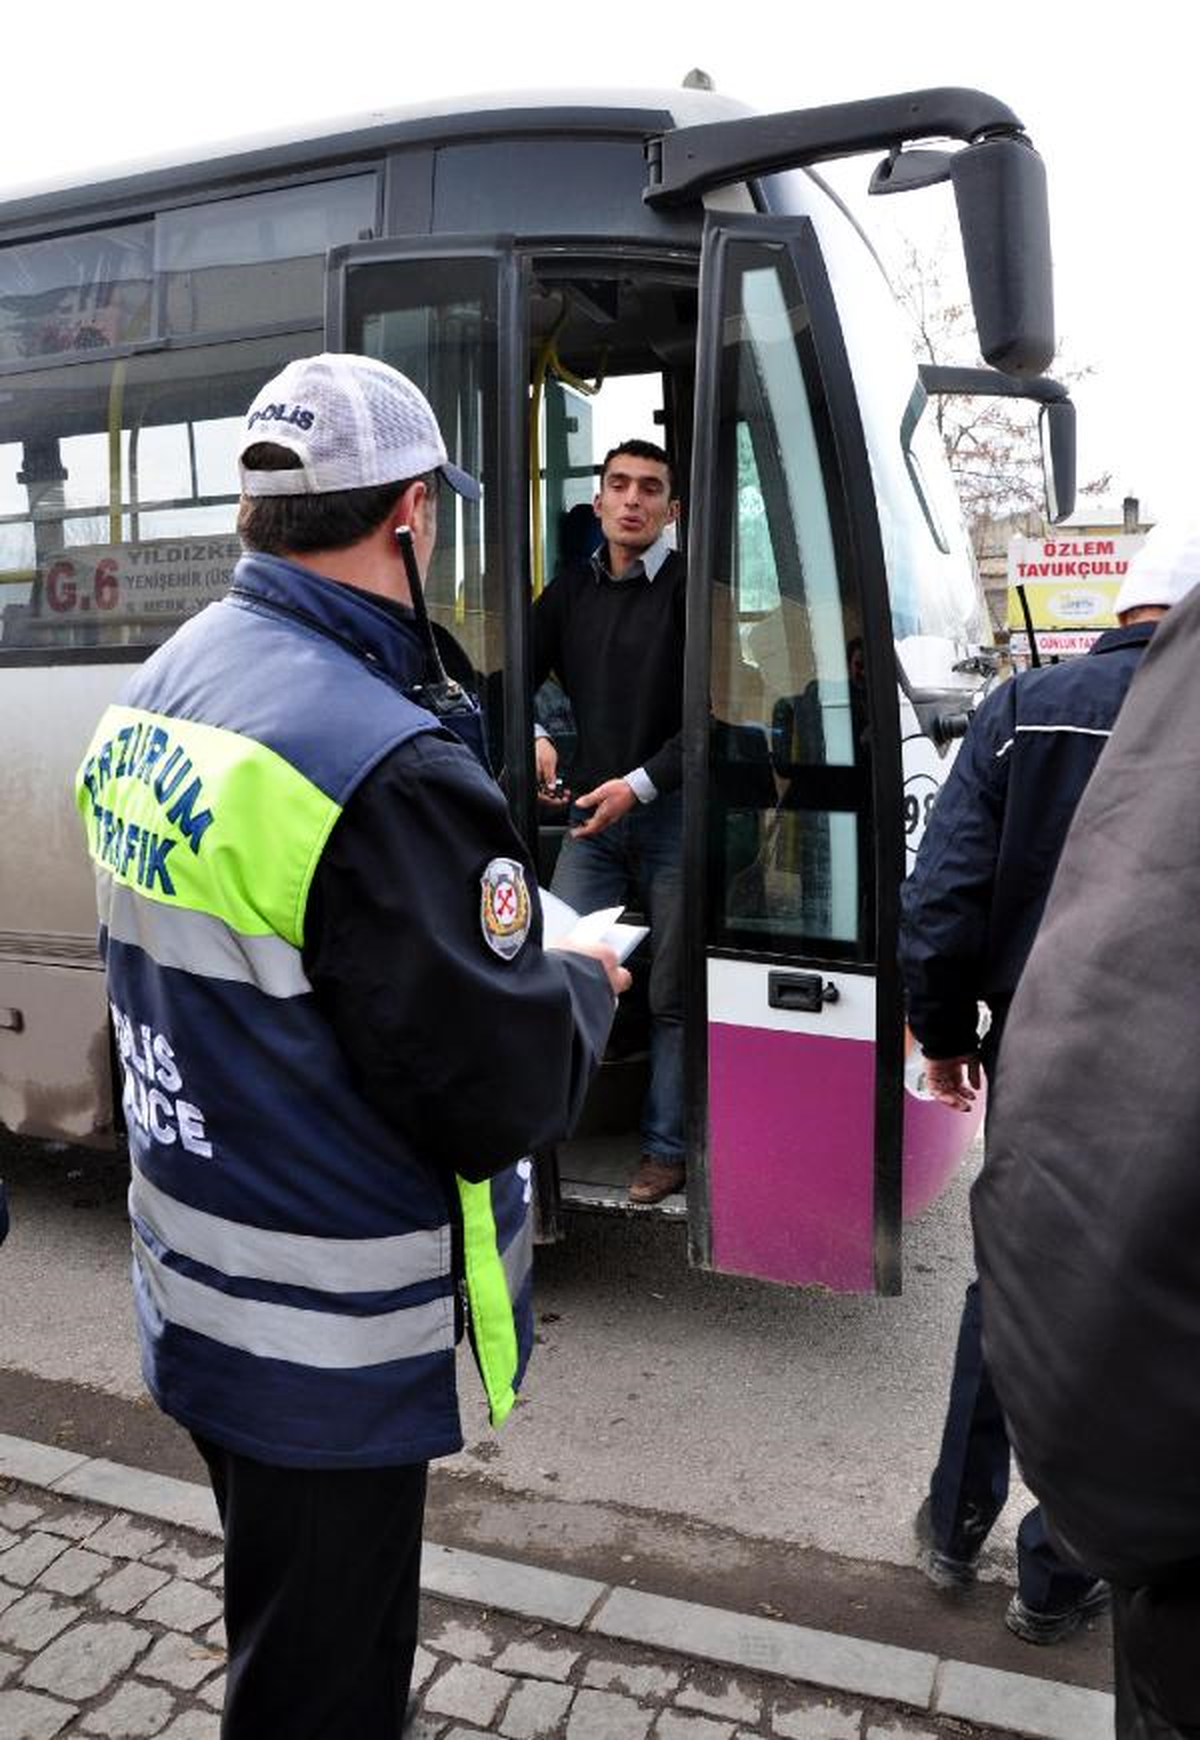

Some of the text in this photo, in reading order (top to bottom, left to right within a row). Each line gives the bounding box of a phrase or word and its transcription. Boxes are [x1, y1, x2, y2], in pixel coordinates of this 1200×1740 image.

[1043, 537, 1115, 557] ÖZLEM
[46, 558, 119, 612] G.6
[1017, 560, 1128, 580] TAVUKÇULU
[84, 724, 215, 856] ERZURUM
